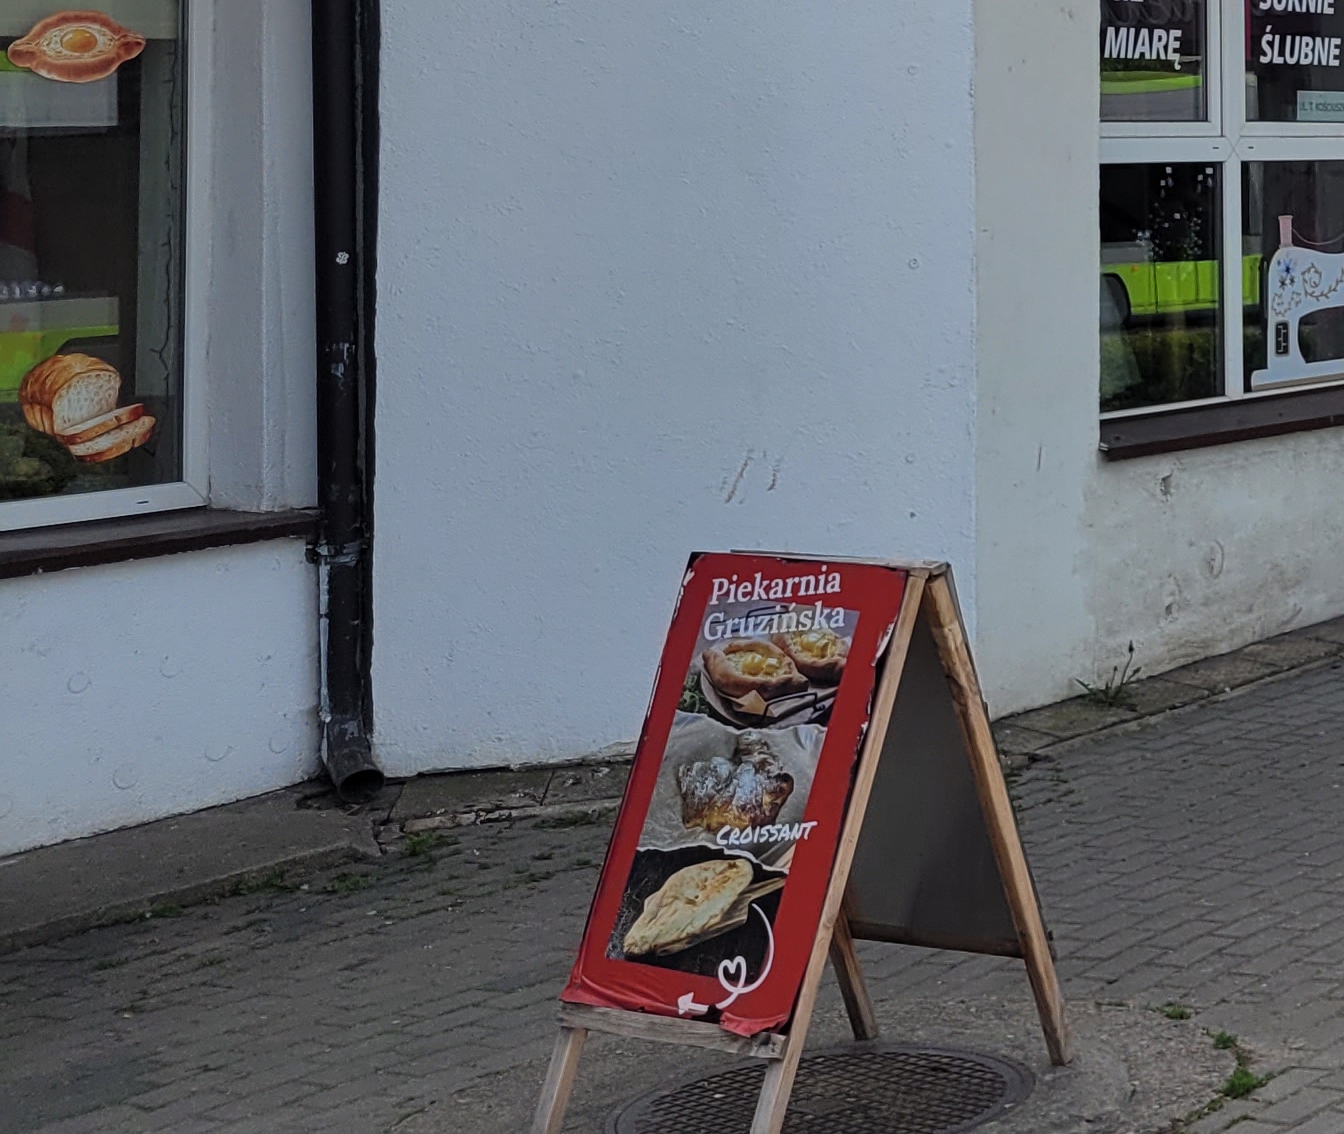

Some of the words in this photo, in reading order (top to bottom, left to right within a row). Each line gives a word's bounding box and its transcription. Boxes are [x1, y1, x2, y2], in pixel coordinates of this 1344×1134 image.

[1104, 26, 1182, 70] MIARĘ
[1260, 24, 1342, 67] ŚLUBNE
[709, 565, 841, 605] Piekarnia
[703, 600, 845, 641] Gruzińska
[716, 821, 818, 847] CROISSANT
